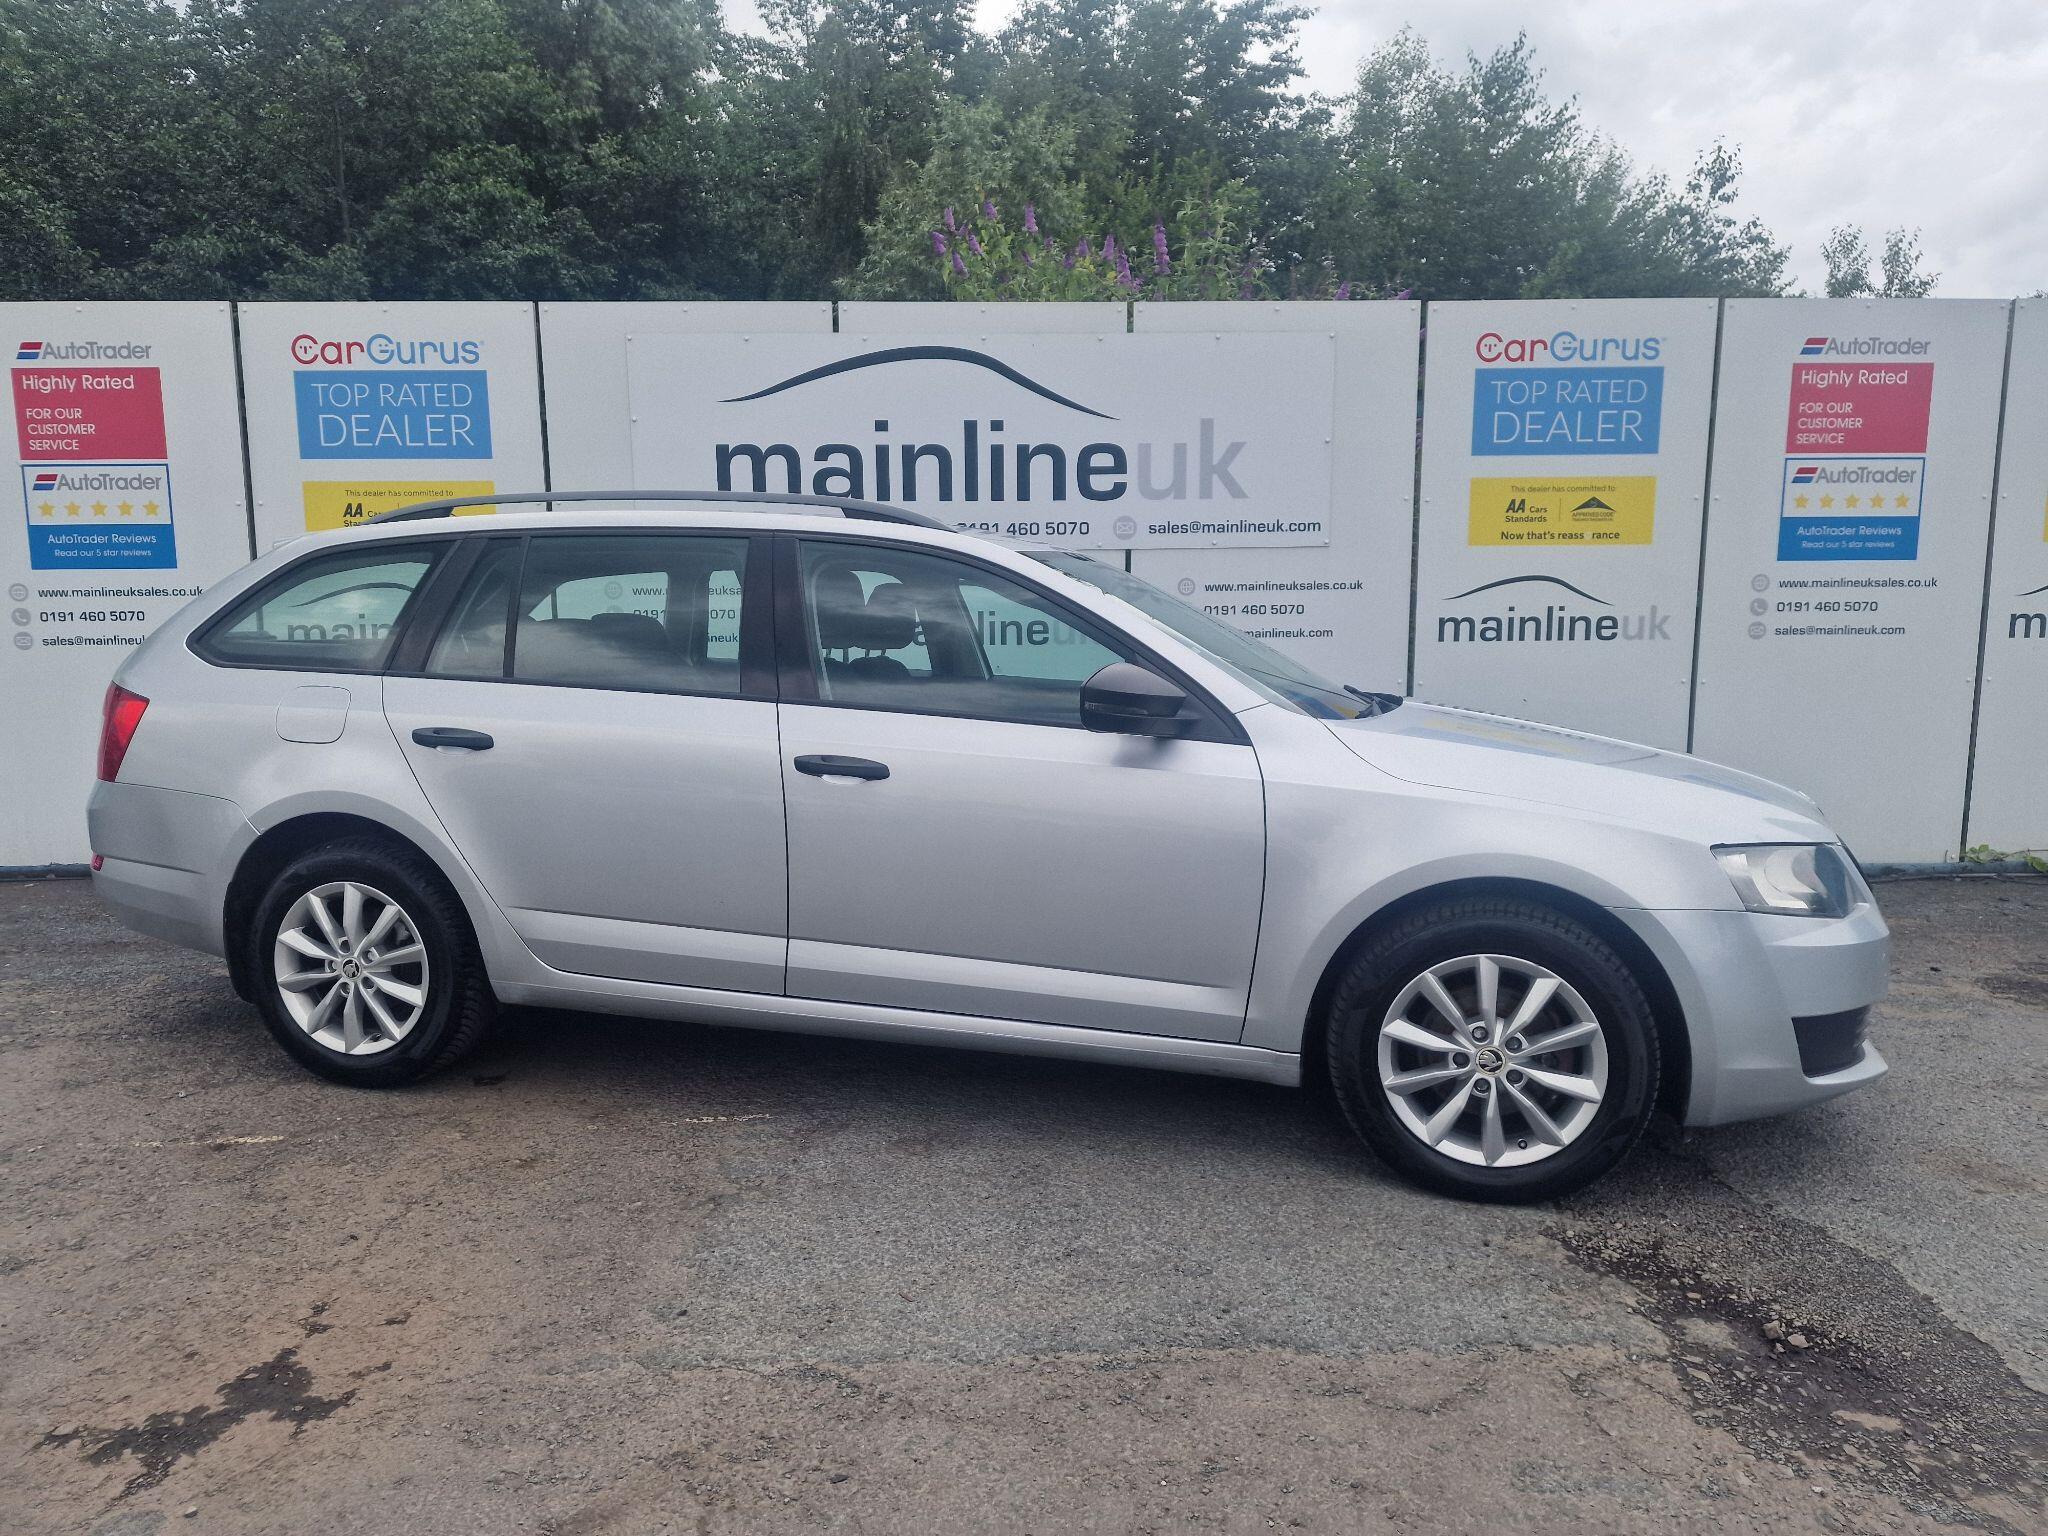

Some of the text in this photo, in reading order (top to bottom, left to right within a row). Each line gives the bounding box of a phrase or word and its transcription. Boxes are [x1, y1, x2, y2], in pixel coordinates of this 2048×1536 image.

[42, 342, 152, 360] AutoTrader
[291, 333, 481, 365] CarGurus
[1475, 331, 1661, 363] CarGurus
[1824, 337, 1931, 355] AutoTrader
[22, 375, 135, 393] Highly Rated
[1801, 370, 1908, 388] Highly Rated
[311, 384, 472, 407] TOP RATED
[1490, 379, 1647, 404] TOP RATED
[1799, 402, 1853, 413] FOR OUR
[26, 408, 82, 420] FOR OUR
[27, 424, 96, 435] CUSTOMER
[1493, 410, 1643, 443] DEALER
[1798, 418, 1863, 429] CUSTOMER
[318, 414, 474, 447] DEALER
[1797, 433, 1845, 444] SERVICE
[29, 439, 80, 451] SERVICE
[1815, 467, 1917, 484] AutoTrader
[57, 474, 162, 491] AutoTrader
[345, 489, 454, 497] This dealer has committed to
[1528, 485, 1550, 493] dealer
[343, 502, 363, 517] AA
[1505, 499, 1548, 513] AA Cars
[1505, 515, 1548, 523] Standards
[1006, 523, 1040, 536] 460
[1045, 522, 1090, 535] 5070
[1148, 519, 1322, 535] sales@mainlineuk.com
[1859, 525, 1902, 535] Reviews
[48, 533, 158, 544] AutoTrader Reviews
[1500, 531, 1525, 540] Now
[1526, 531, 1556, 540] that's
[54, 549, 78, 557] Read
[96, 549, 102, 557] 5
[103, 549, 119, 557] star
[1204, 580, 1364, 592] www.mainlineuksales.co.uk
[1779, 577, 1938, 588] www.mainlineuksales.co.uk
[38, 586, 204, 598] www.mainlineuksales.co.uk
[1241, 605, 1267, 615] 460
[1270, 604, 1305, 615] 5070
[1776, 601, 1878, 612] 0191 460 5070
[40, 611, 145, 622] 0191 460 5070
[1775, 626, 1905, 636] sales@mainlineuk.com
